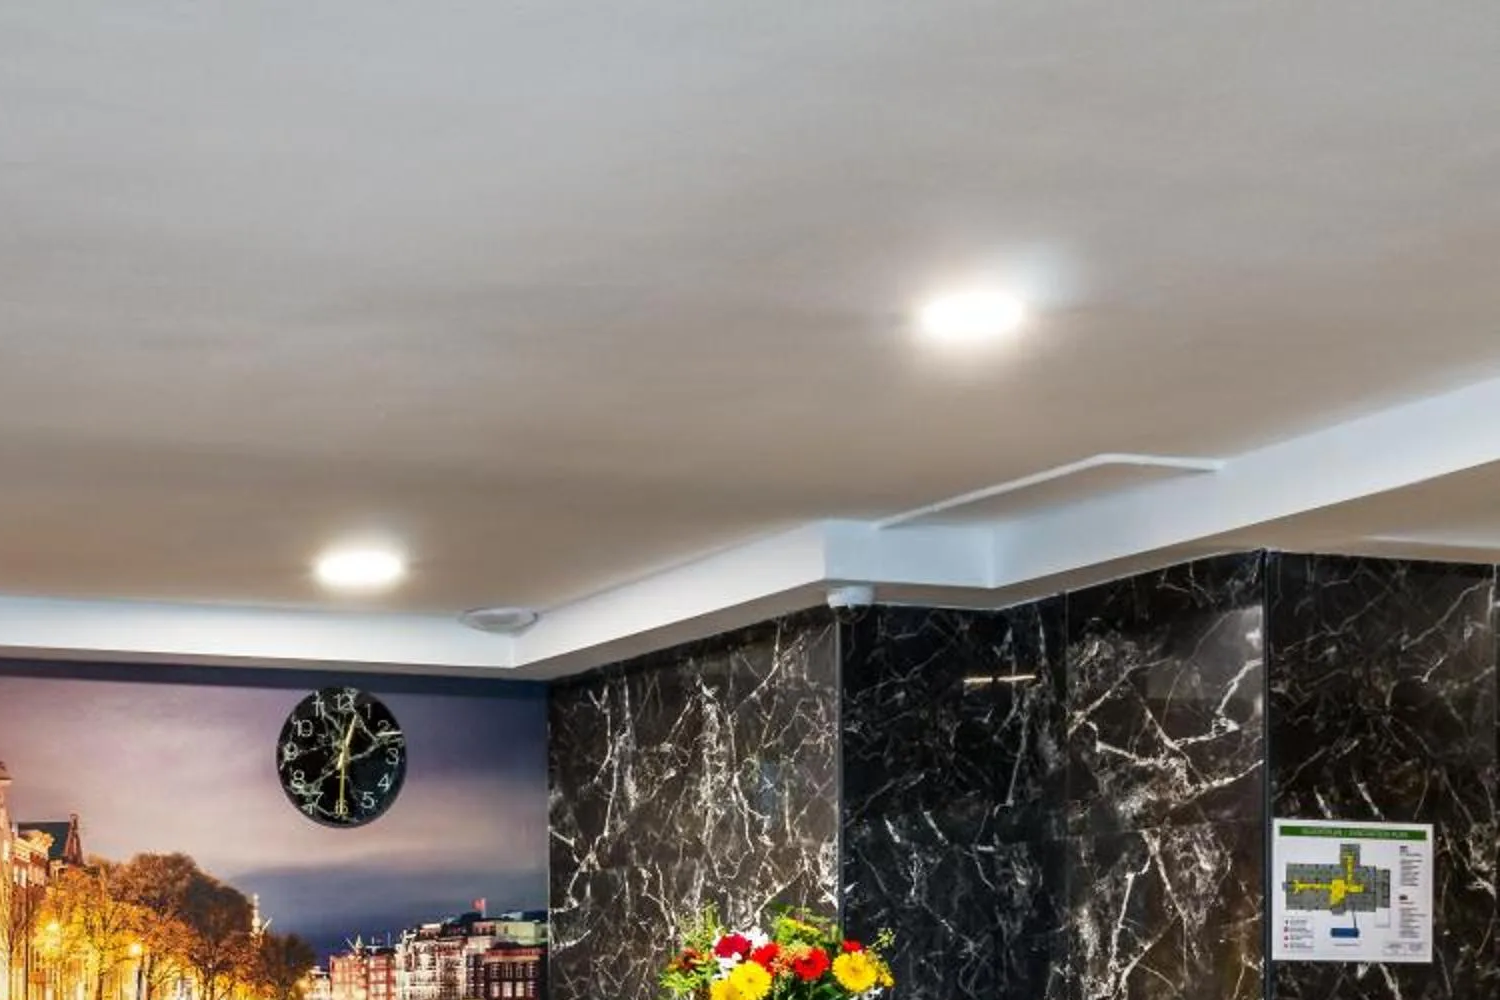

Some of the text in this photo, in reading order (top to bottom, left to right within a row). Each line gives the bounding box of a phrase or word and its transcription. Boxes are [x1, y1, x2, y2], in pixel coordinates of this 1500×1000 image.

[295, 719, 313, 737] 10
[284, 742, 298, 761] 9
[385, 747, 399, 765] 3
[377, 773, 391, 792] 4
[361, 791, 375, 809] 5
